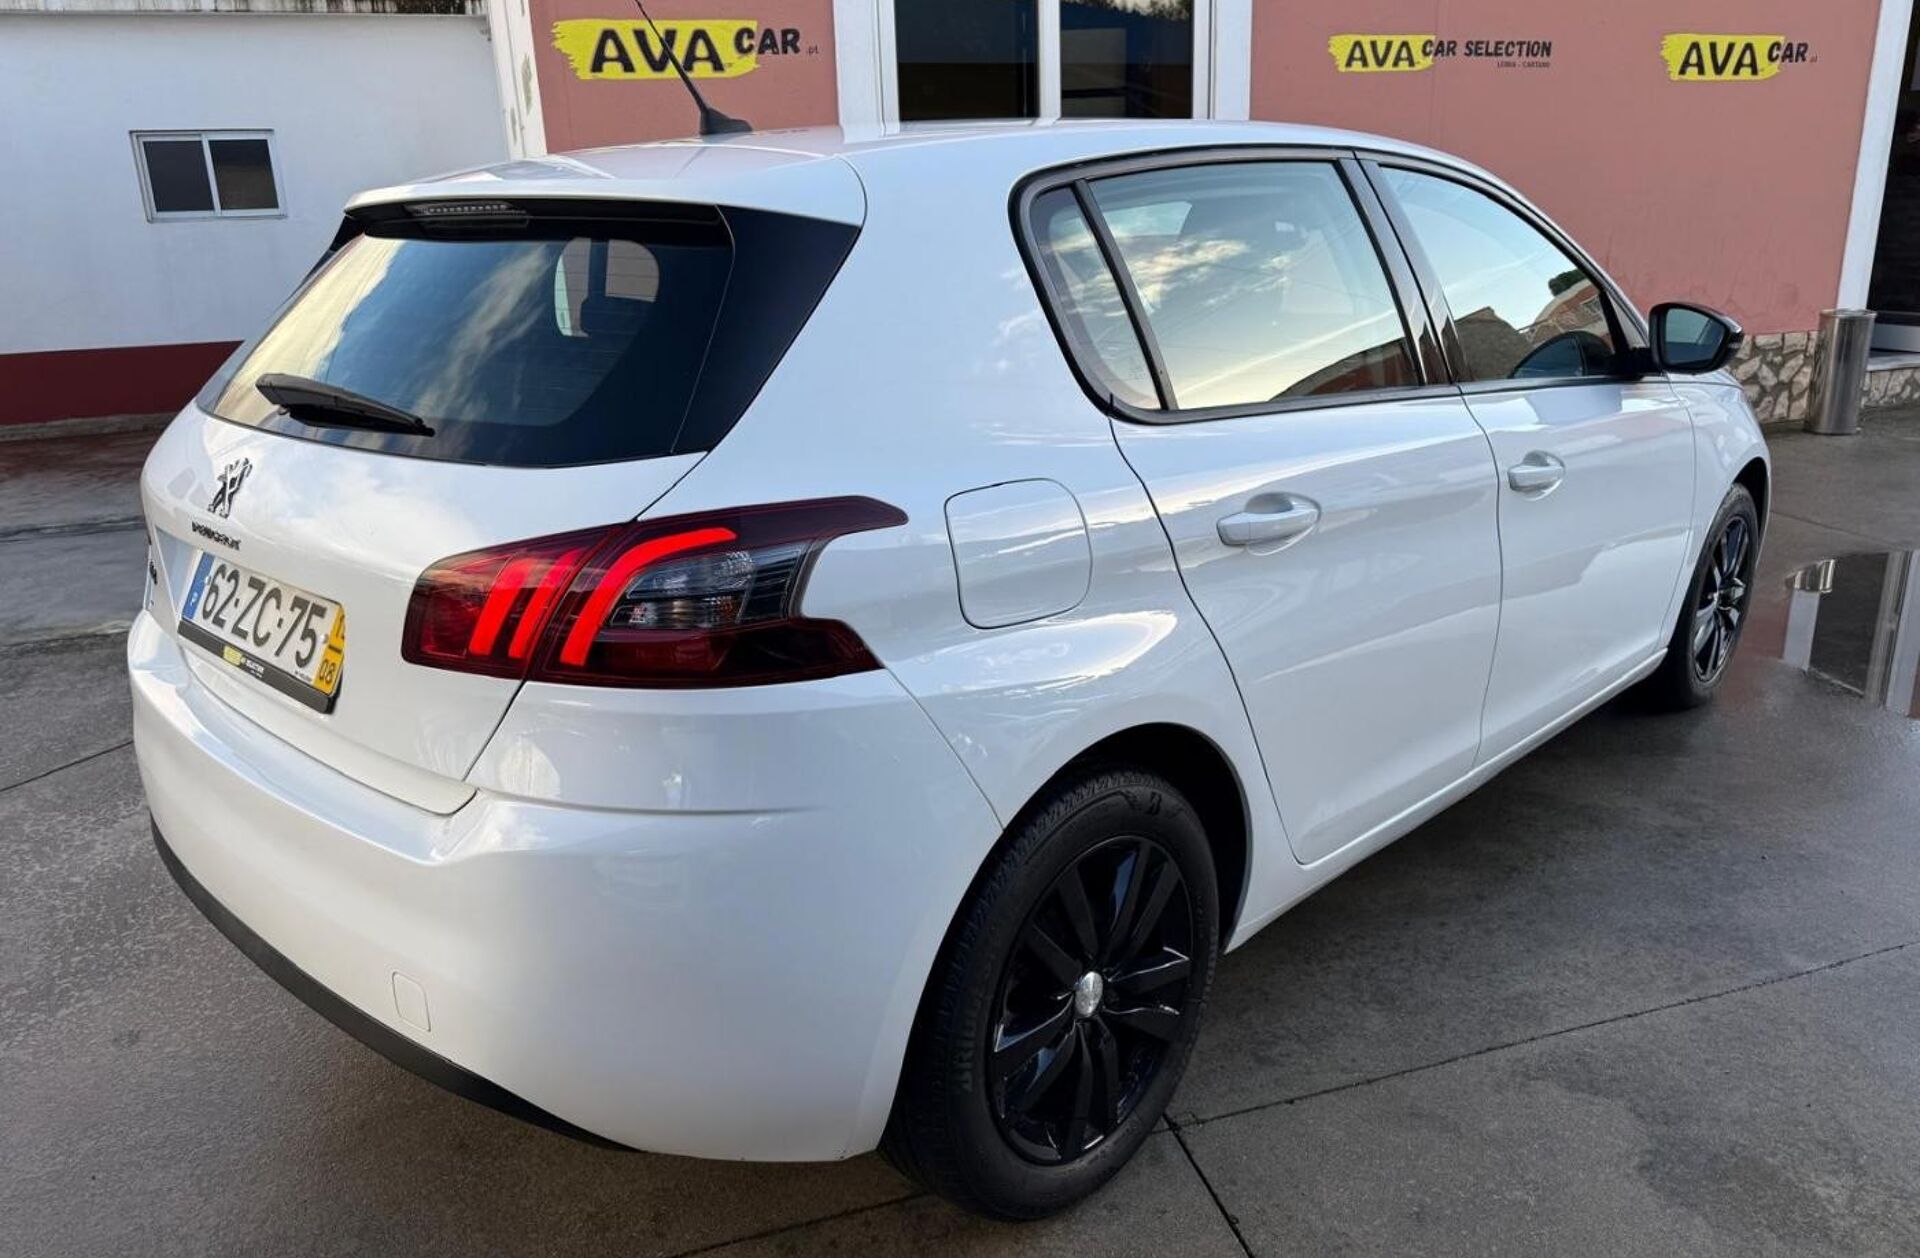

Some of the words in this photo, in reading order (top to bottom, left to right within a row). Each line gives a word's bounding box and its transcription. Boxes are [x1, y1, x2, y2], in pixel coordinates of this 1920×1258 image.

[590, 28, 725, 73] AVA
[733, 27, 800, 54] CAR
[1345, 40, 1417, 68] AVA
[1421, 39, 1457, 57] CAR
[1463, 40, 1552, 57] SELECTION
[1678, 41, 1758, 76] AVA
[1767, 41, 1809, 63] CAR
[201, 563, 328, 668] 62-ZC-75
